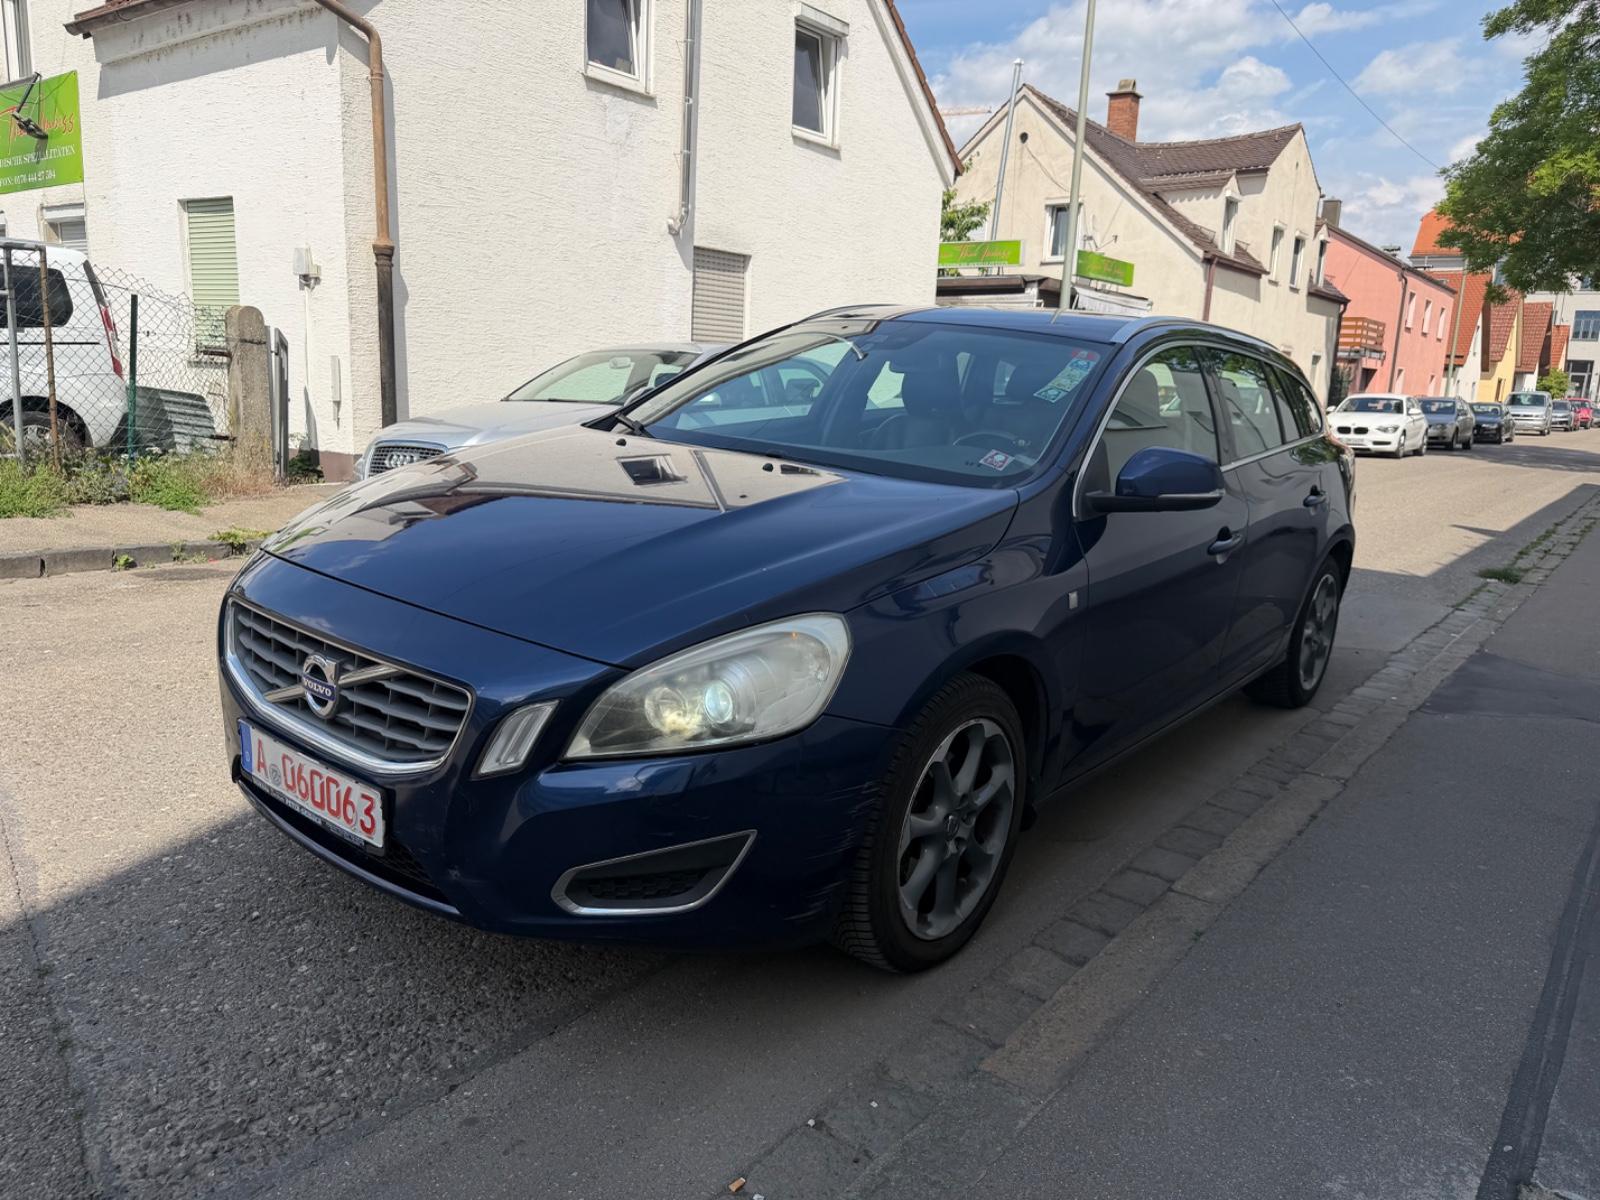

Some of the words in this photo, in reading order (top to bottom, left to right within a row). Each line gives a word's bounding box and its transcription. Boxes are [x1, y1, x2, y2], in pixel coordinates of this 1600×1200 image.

[304, 678, 332, 697] VOLVO
[256, 738, 269, 780] A
[281, 753, 377, 837] 060063
